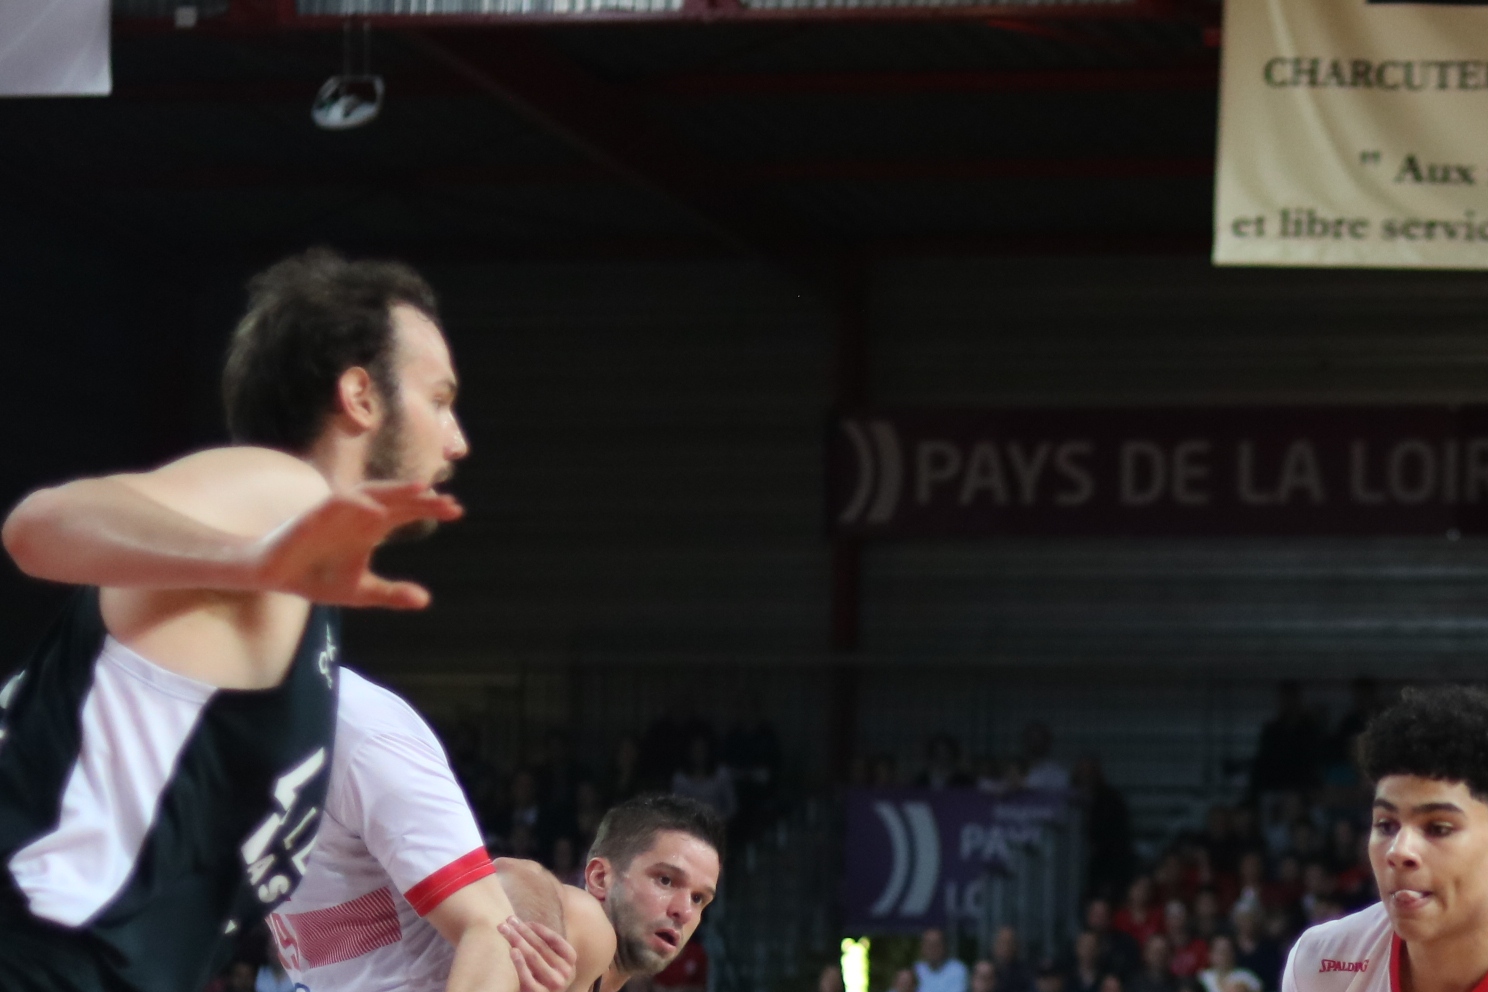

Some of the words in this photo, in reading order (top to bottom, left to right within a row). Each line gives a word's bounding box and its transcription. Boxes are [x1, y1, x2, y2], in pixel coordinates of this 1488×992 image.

[1395, 153, 1475, 186] Aux
[1231, 215, 1266, 239] et
[1279, 207, 1370, 240] libre
[912, 438, 1095, 508] PAYS
[1118, 439, 1213, 507] DE
[1236, 438, 1327, 506] LA
